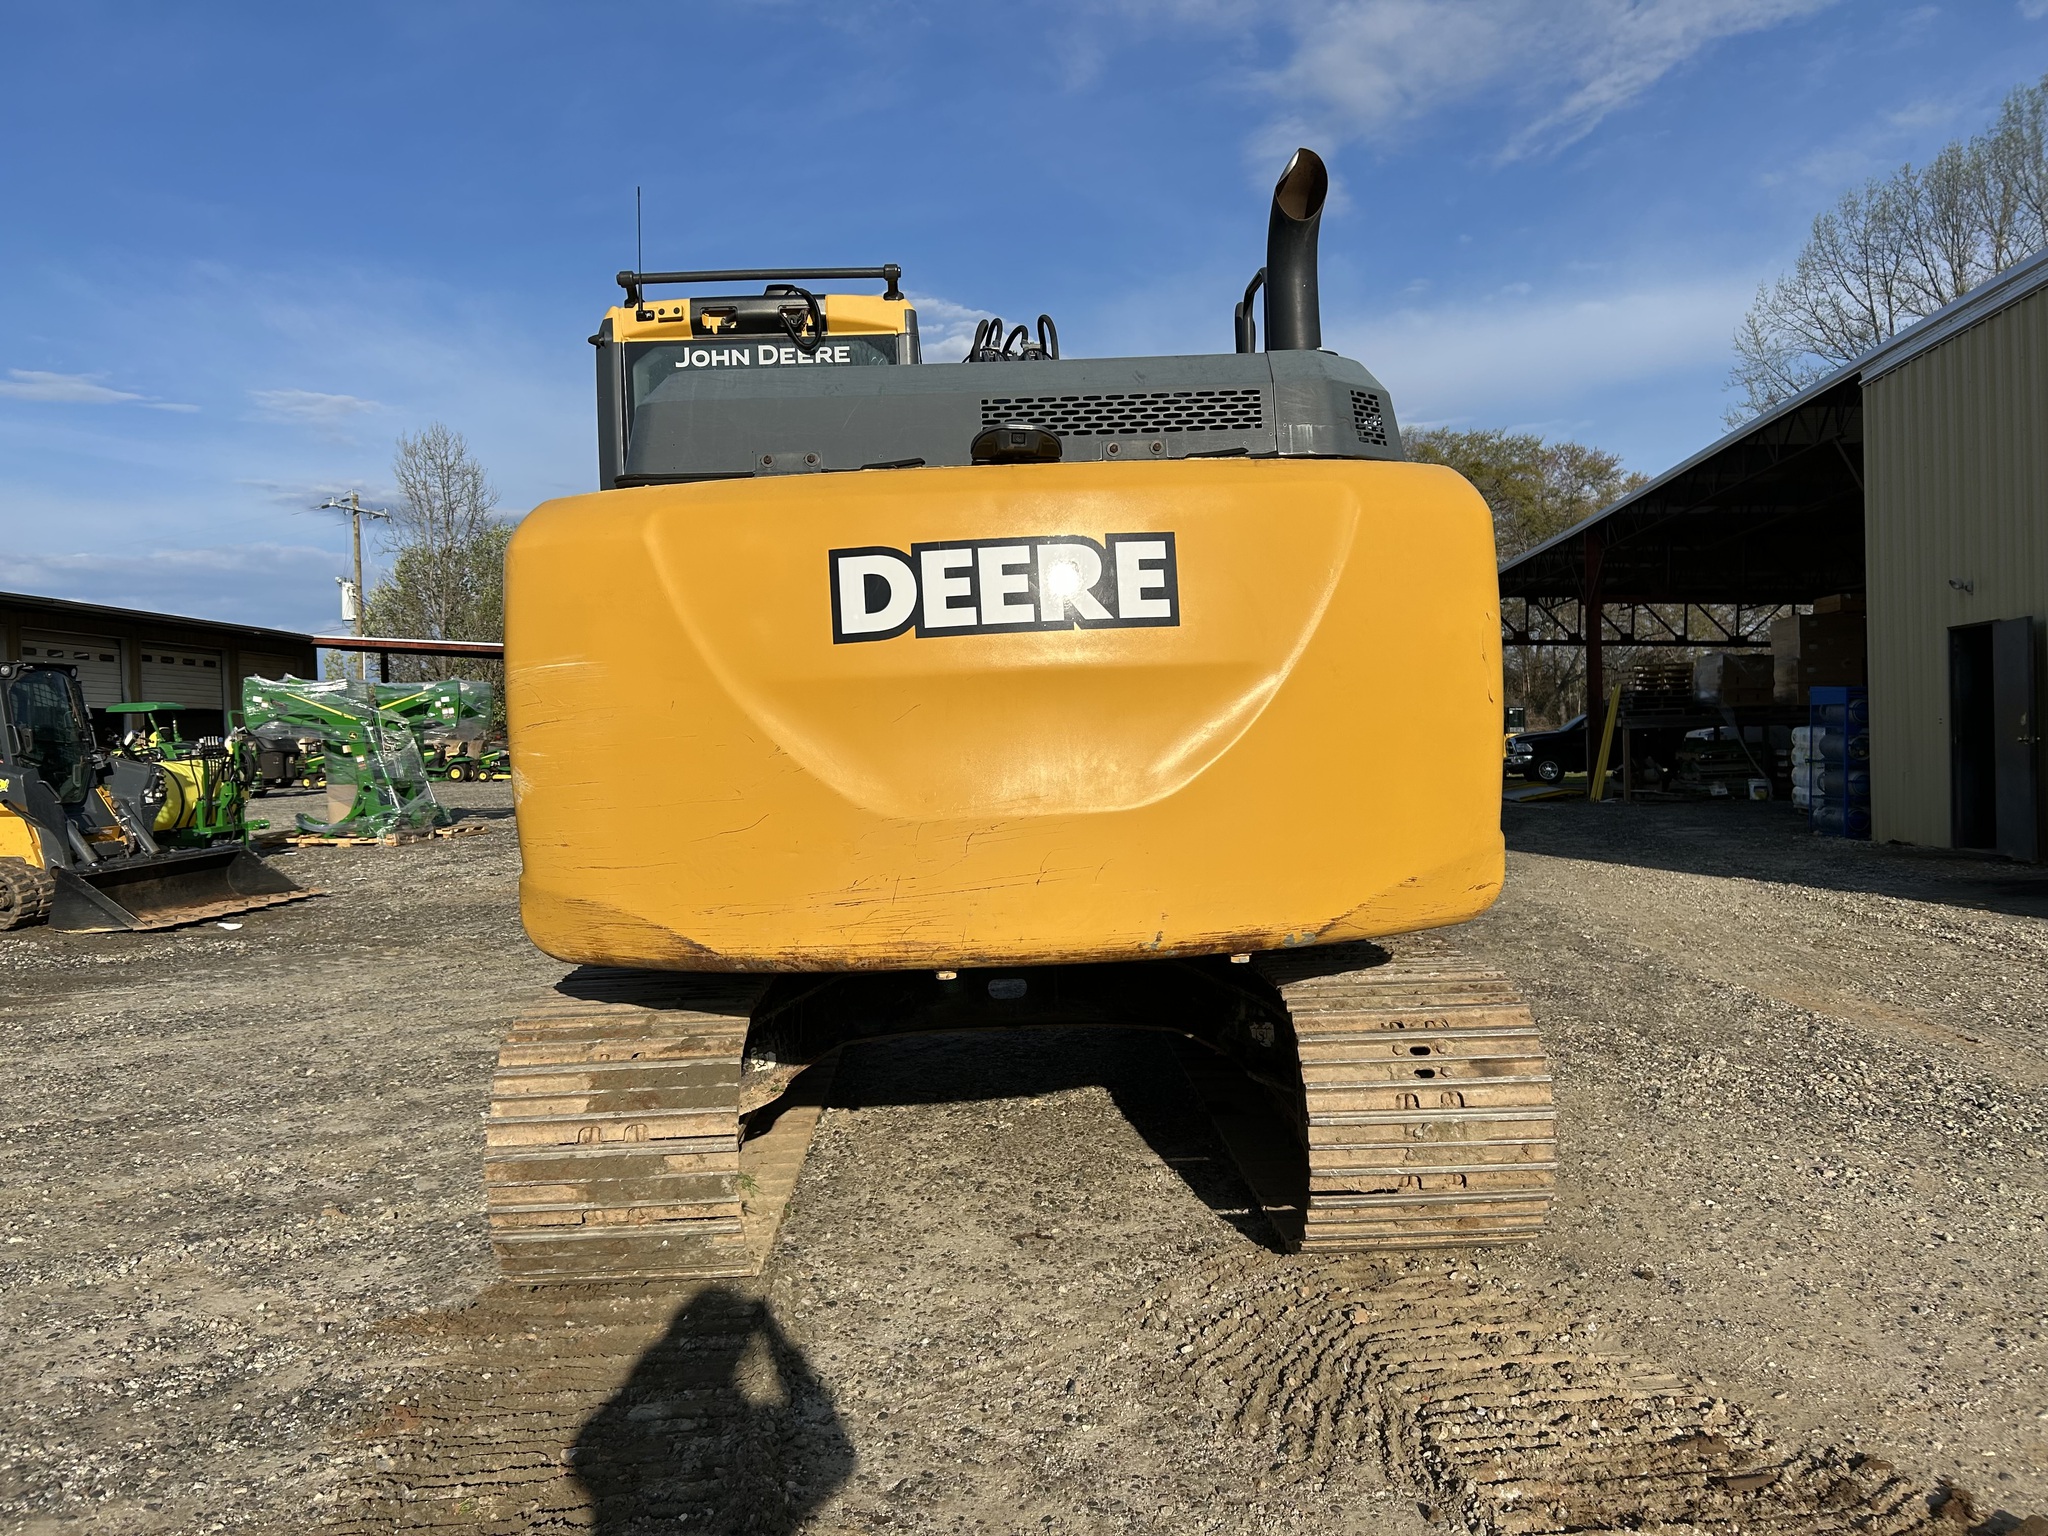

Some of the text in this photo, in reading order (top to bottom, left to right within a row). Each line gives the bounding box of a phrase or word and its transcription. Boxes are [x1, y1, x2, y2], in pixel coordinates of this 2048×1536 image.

[675, 345, 851, 368] JOHN DEERE
[837, 540, 1171, 635] DEERE
